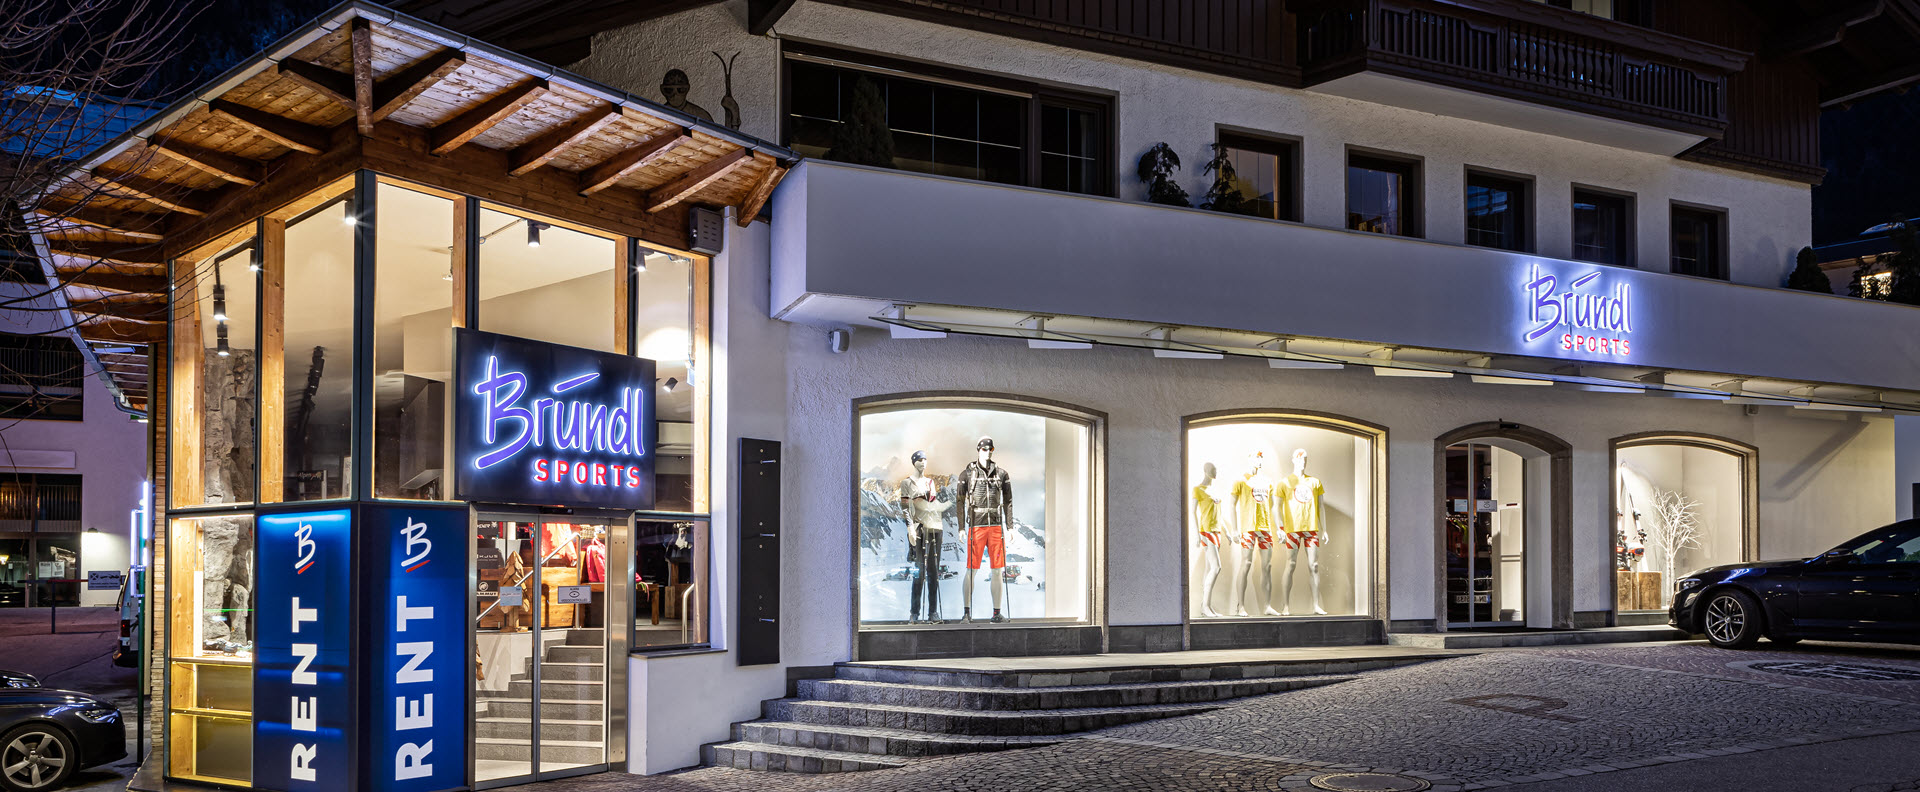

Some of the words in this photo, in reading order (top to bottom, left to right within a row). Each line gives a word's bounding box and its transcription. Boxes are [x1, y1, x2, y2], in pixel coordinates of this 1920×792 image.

[1561, 333, 1631, 356] SPORTS
[533, 458, 641, 489] SPORTS
[294, 520, 316, 570] B
[401, 516, 432, 568] B
[290, 596, 318, 782] RENT
[395, 595, 434, 781] RENT
